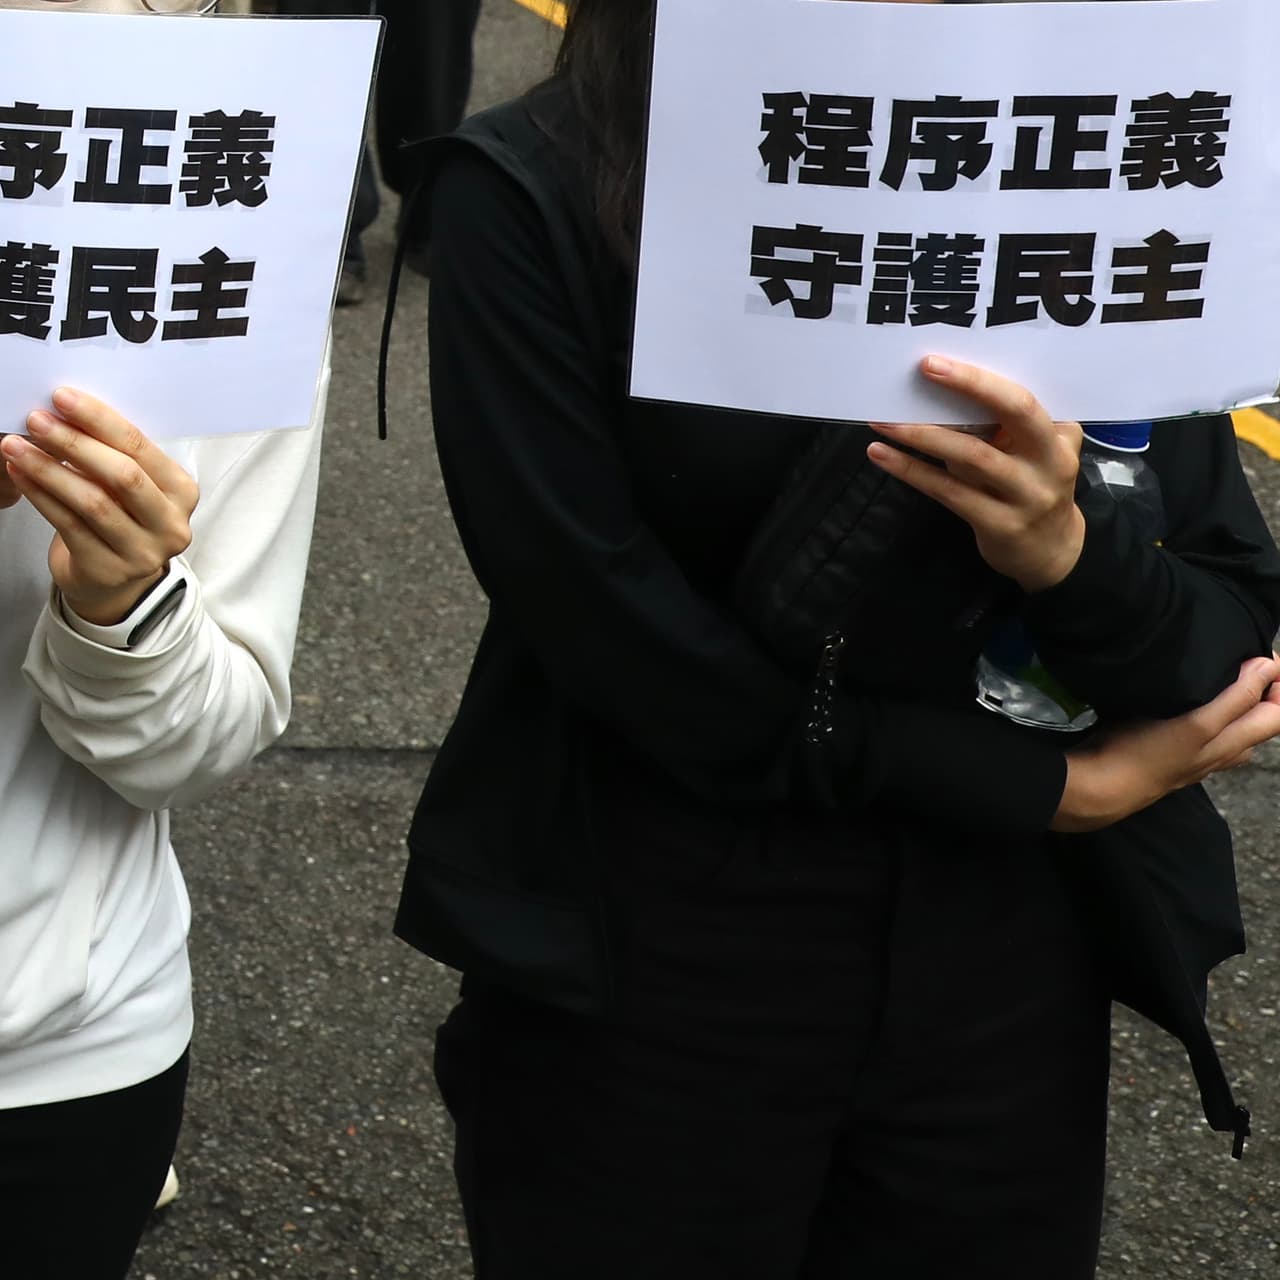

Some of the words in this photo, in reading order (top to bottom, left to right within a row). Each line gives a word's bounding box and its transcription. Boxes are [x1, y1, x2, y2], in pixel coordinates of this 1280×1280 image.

[759, 91, 1232, 192] 程序正義
[749, 223, 1211, 328] 守護民主
